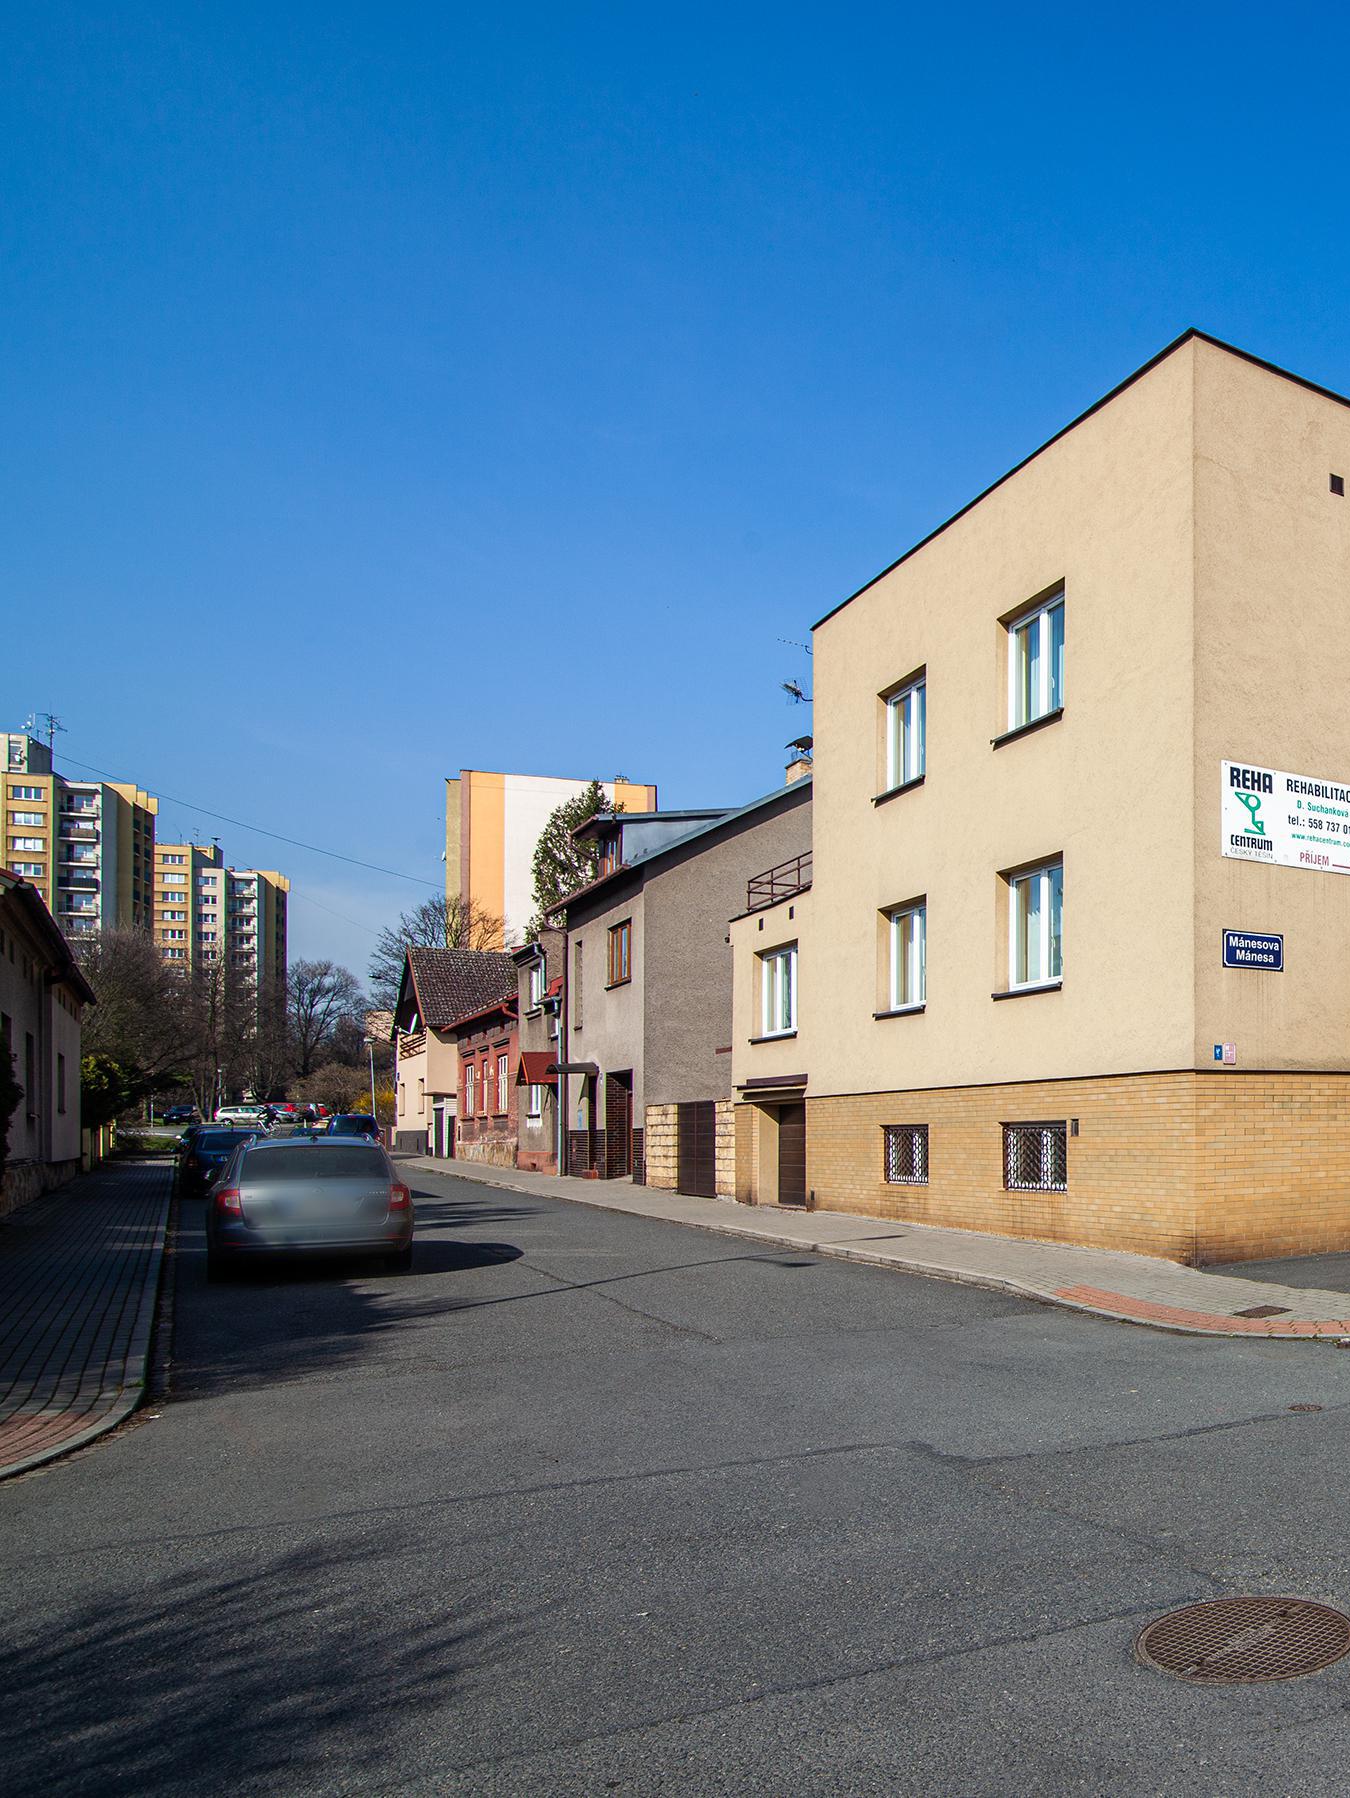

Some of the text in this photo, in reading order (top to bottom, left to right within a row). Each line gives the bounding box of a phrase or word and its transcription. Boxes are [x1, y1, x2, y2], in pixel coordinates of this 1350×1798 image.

[1230, 766, 1273, 794] REHA
[1296, 800, 1305, 810] D.
[1287, 814, 1305, 827] tel.:
[1308, 818, 1323, 830] 558
[1326, 820, 1340, 833] 737
[1299, 849, 1330, 866] PŘÍJEM
[1229, 936, 1279, 951] Mánesova
[1236, 949, 1274, 963] Mánesa
